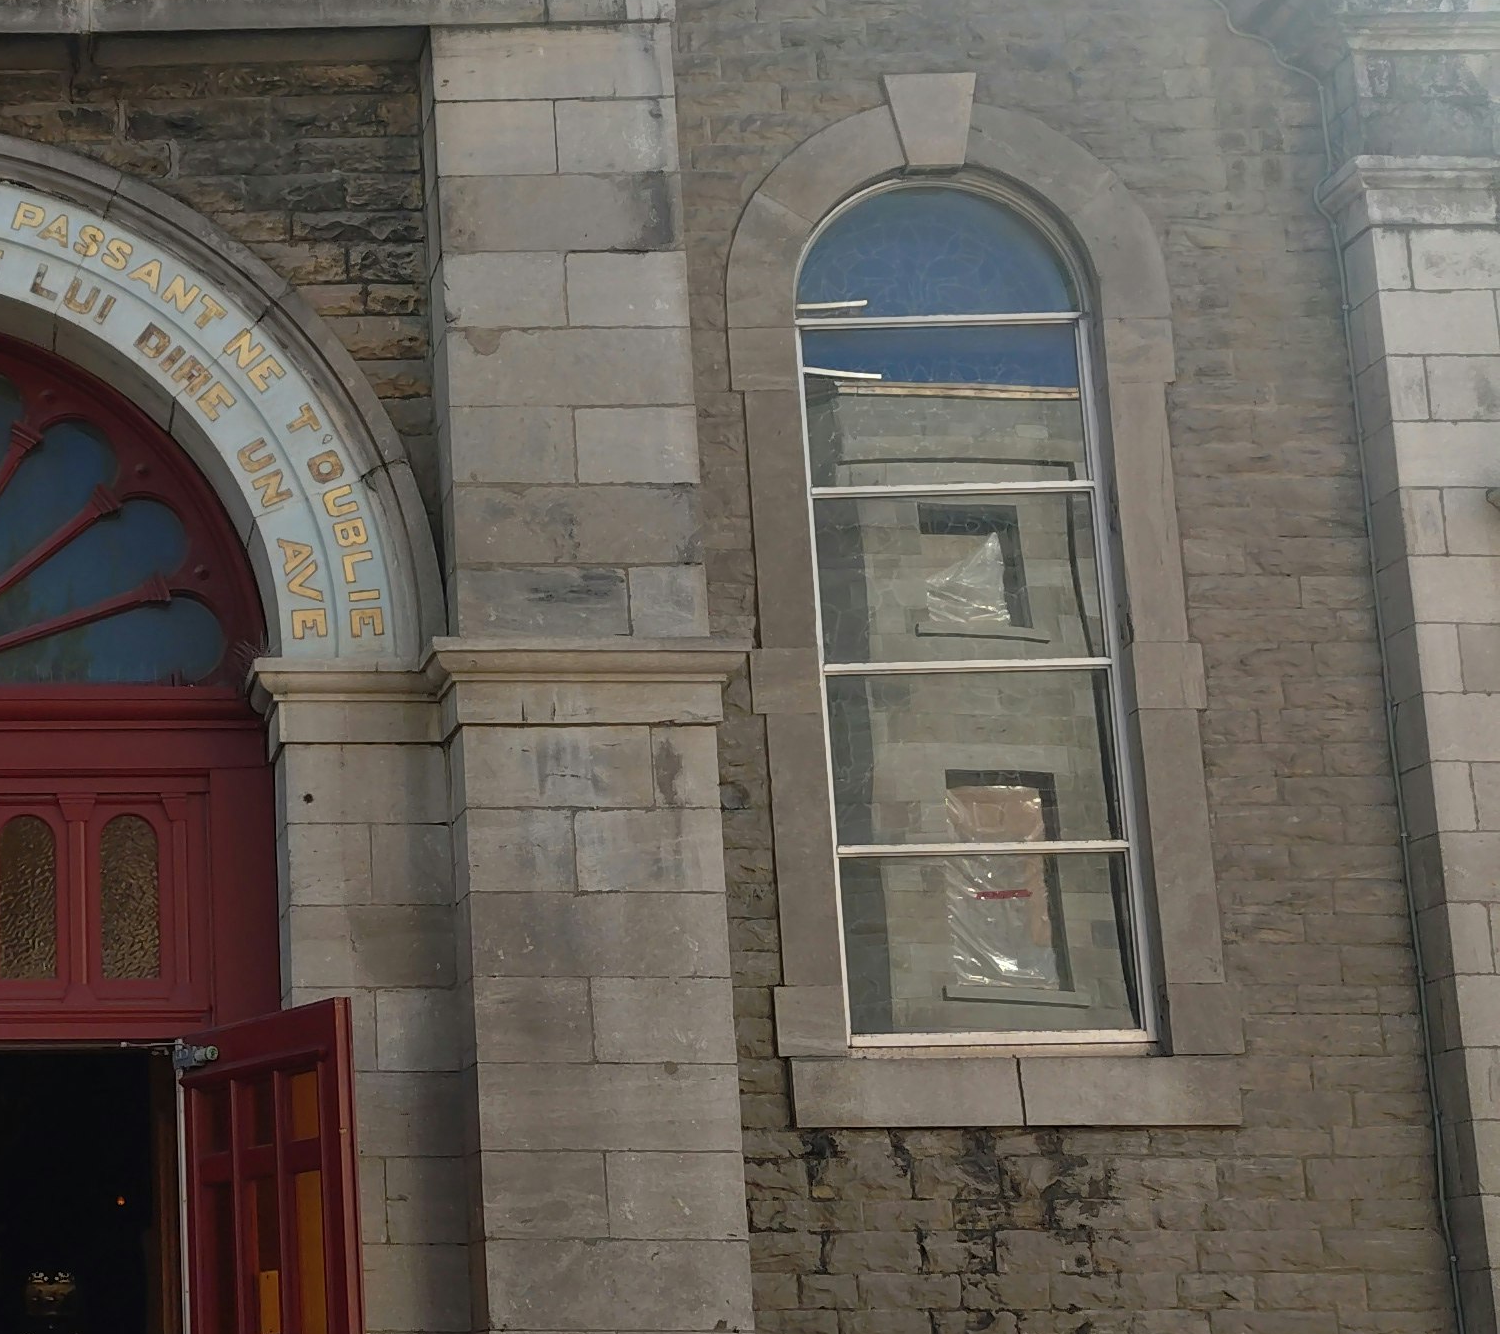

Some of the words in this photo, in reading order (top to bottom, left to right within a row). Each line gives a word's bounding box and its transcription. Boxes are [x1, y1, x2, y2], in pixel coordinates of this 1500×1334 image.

[10, 201, 228, 330] PASSANT
[223, 327, 287, 394] NE
[286, 402, 386, 639] T'OUBLIE
[29, 263, 117, 326] LUI
[133, 321, 238, 422] DIRE
[236, 436, 294, 509] UN
[275, 537, 329, 641] AVE
